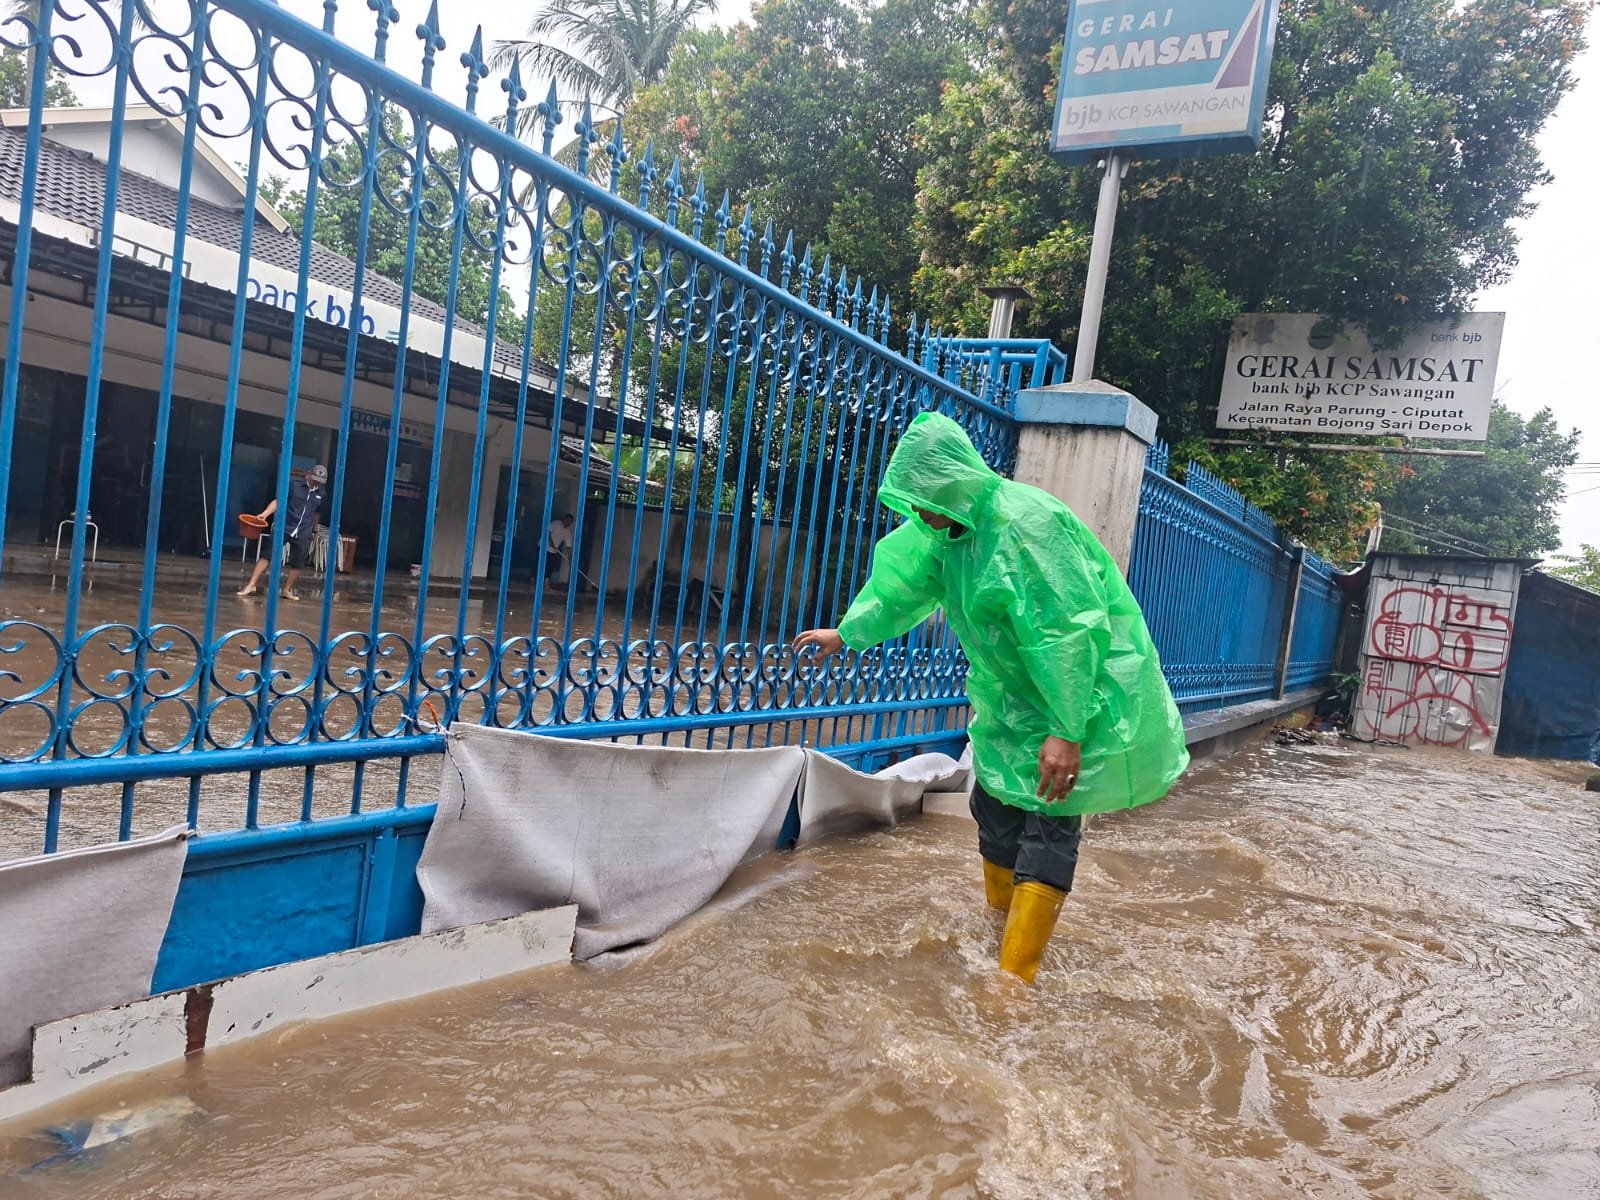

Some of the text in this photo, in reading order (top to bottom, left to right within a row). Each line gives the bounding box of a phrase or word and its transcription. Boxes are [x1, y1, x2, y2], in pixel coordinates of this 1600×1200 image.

[1077, 8, 1174, 38] GERAI
[1073, 29, 1230, 75] SAMSAT
[1066, 94, 1246, 130] bjb KCP SAWANGAN
[326, 295, 375, 335] bb
[1431, 332, 1483, 344] bank bjb
[1236, 355, 1484, 383] GERAI SAMSAT
[1252, 382, 1455, 402] bank bjb KCP Sawangan
[1228, 413, 1473, 433] Kecamatan Bojong Sari Depok
[1239, 402, 1279, 412] Jalan
[1284, 402, 1322, 416] Raya
[1328, 404, 1385, 418] Parung
[1402, 406, 1464, 419] Ciputat
